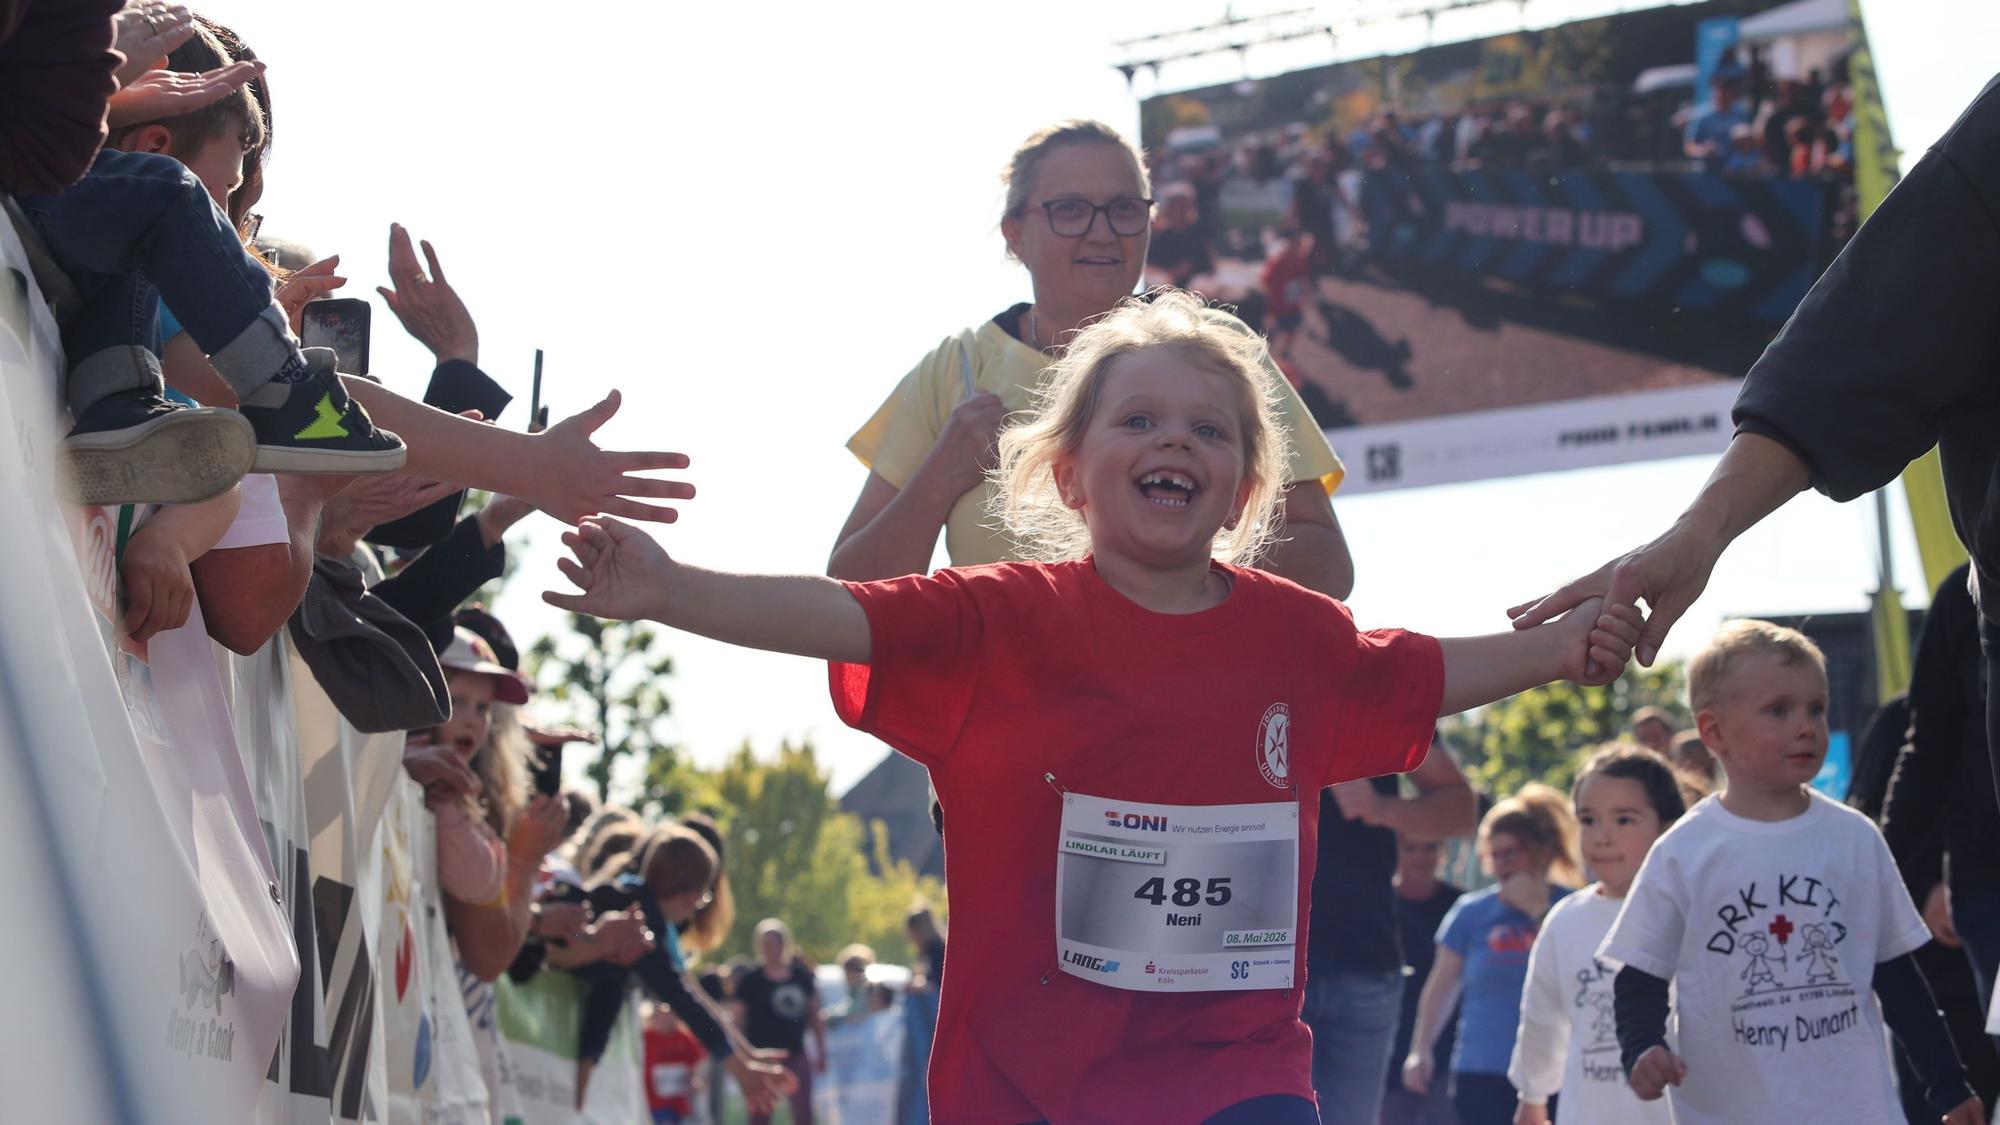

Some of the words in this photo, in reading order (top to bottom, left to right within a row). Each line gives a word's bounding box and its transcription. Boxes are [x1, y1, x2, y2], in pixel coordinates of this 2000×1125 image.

[1445, 202, 1572, 243] POWER
[1578, 213, 1645, 251] UP
[1123, 813, 1168, 832] ONI
[1172, 824, 1186, 833] Wir
[1188, 825, 1213, 834] nutzen
[1215, 824, 1240, 834] Energie
[1241, 822, 1265, 833] sinnvoll
[1065, 840, 1119, 856] LINDLAR
[1121, 847, 1161, 861] LÄUFT
[1134, 877, 1232, 907] 485
[1166, 913, 1201, 927] Neni
[1706, 881, 1768, 955] DRK
[1779, 873, 1847, 945] KITA
[1226, 934, 1242, 944] 08.
[1243, 933, 1263, 943] Mai
[1263, 932, 1287, 942] 2026
[1063, 950, 1103, 970] LANG
[1231, 960, 1249, 980] SC
[1158, 967, 1209, 976] Kreissparkasse
[1158, 977, 1175, 985] Köln
[1732, 1016, 1789, 1052] Henry
[1796, 1002, 1858, 1042] Dunant
[198, 1022, 207, 1056] a
[208, 1017, 235, 1063] Cook
